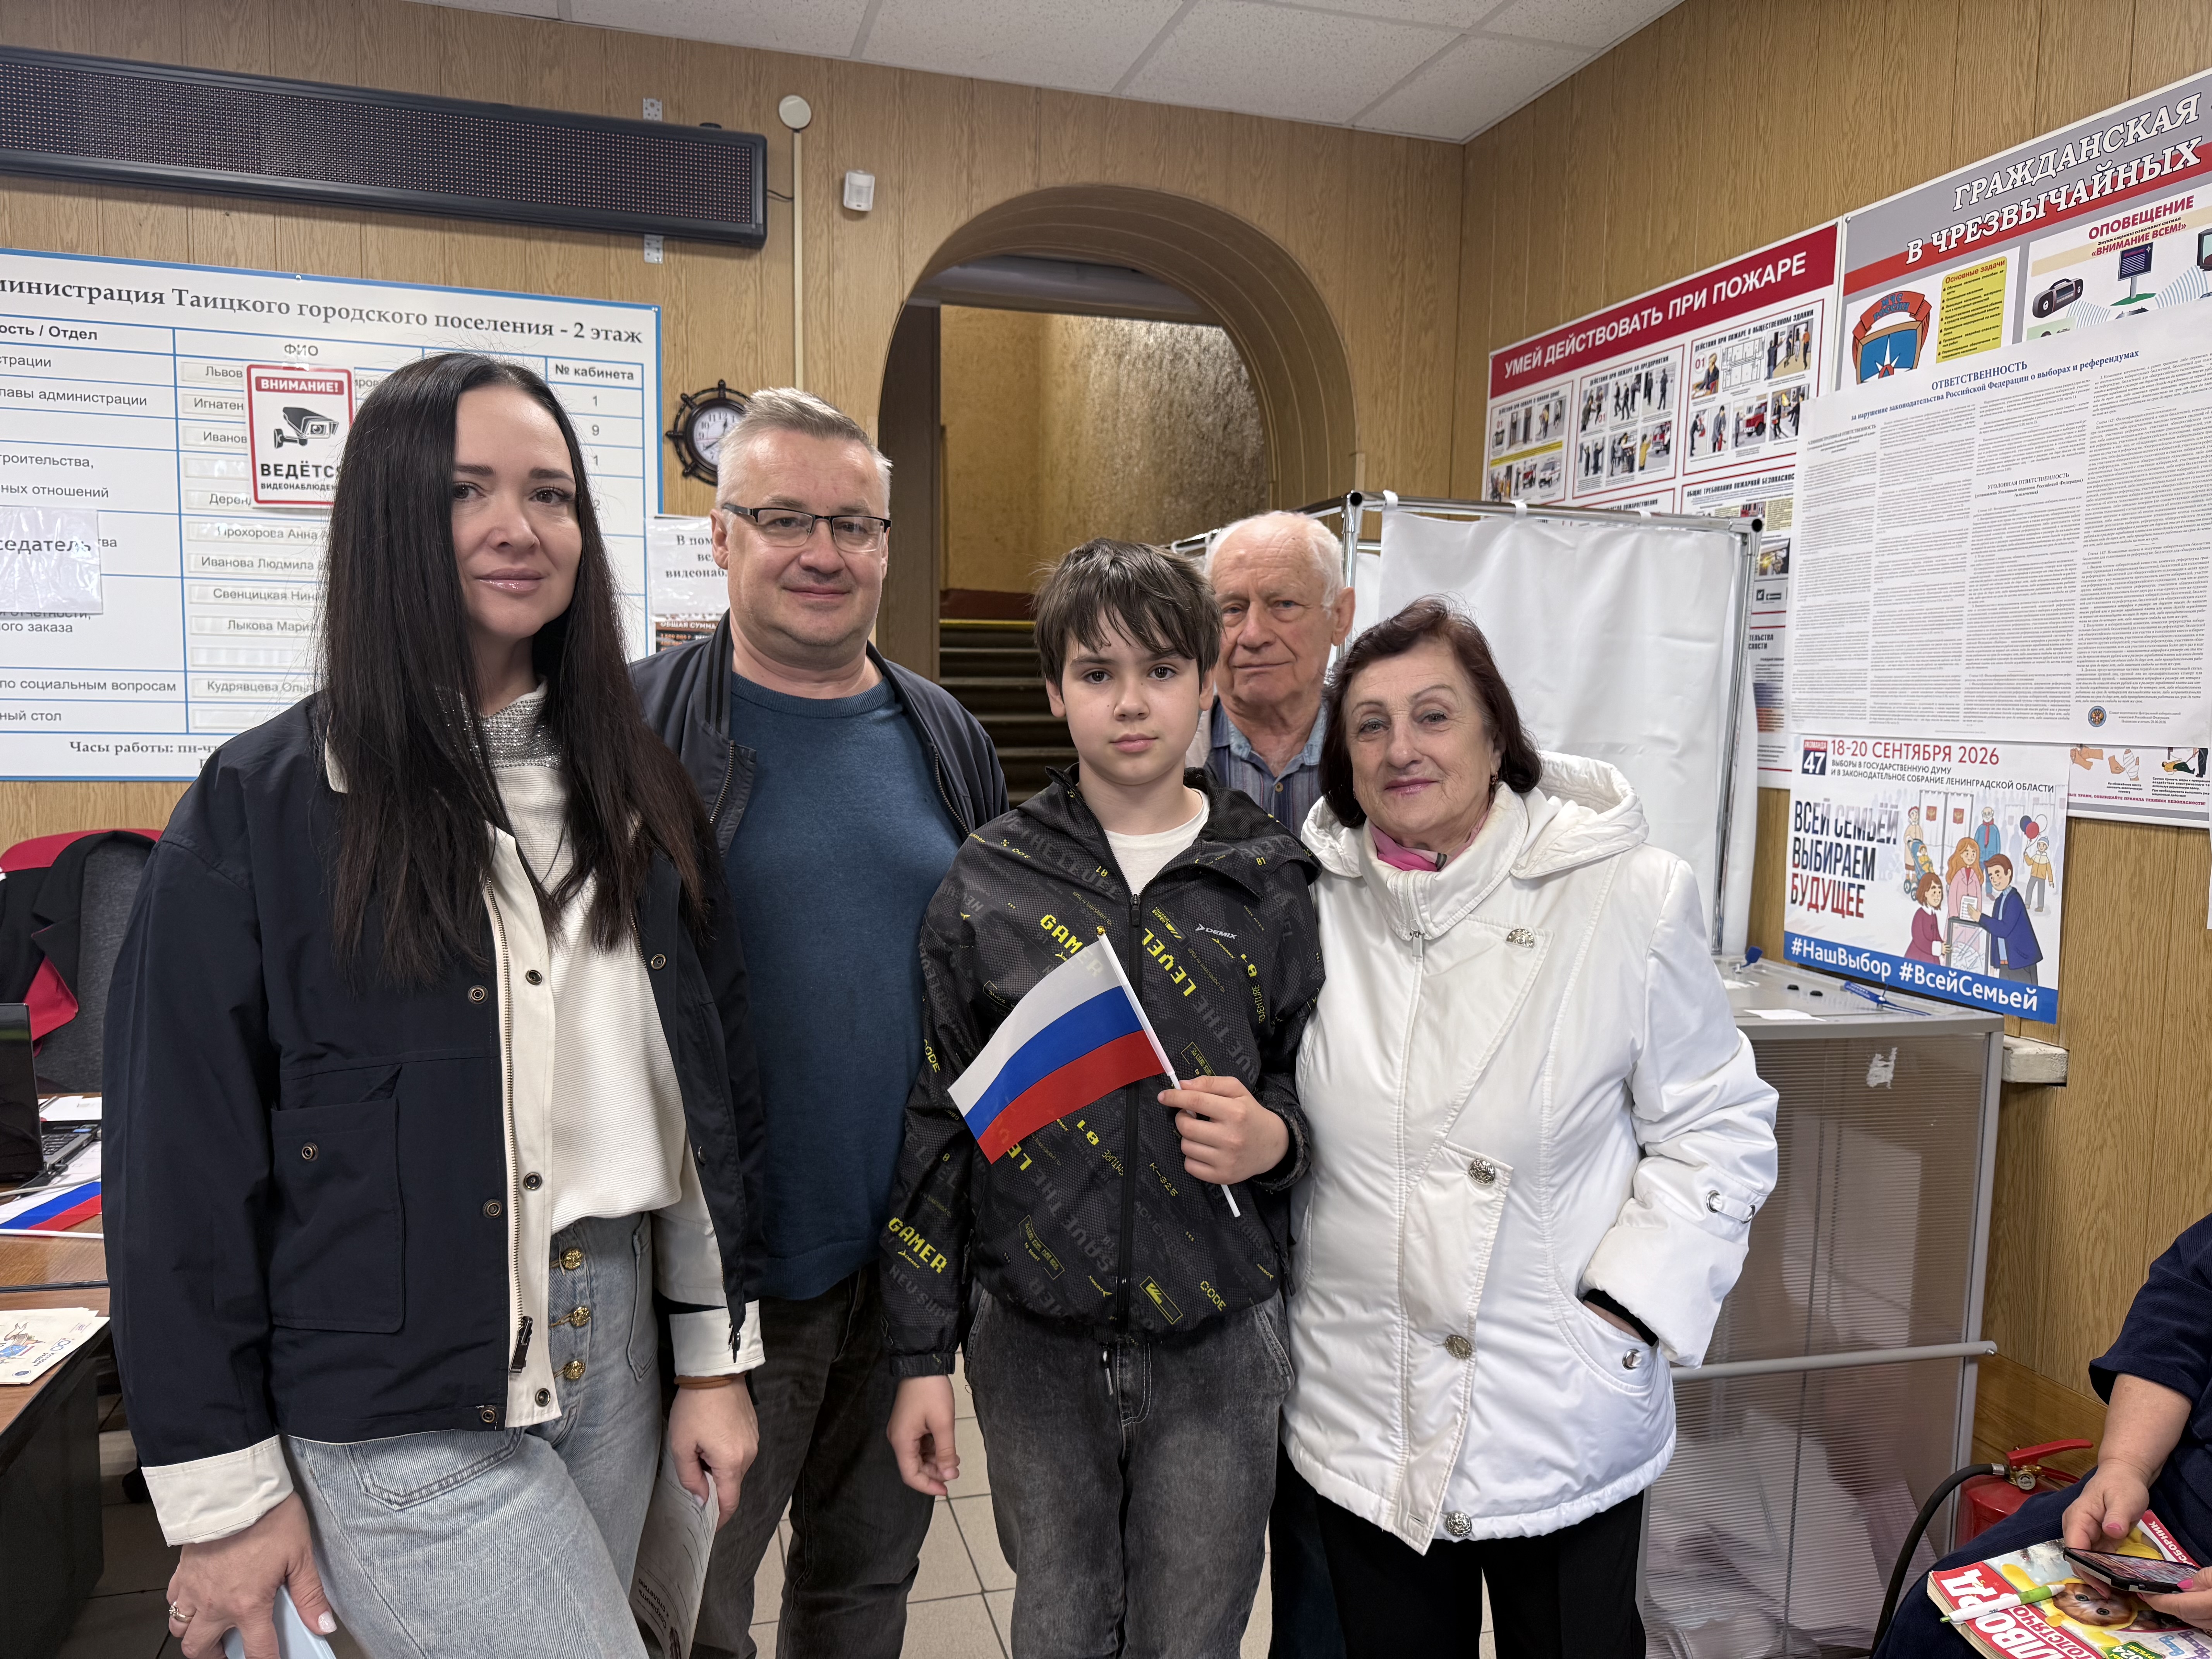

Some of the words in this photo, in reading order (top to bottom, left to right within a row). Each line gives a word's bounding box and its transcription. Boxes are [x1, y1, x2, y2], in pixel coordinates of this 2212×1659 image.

[1953, 92, 2202, 212] ГРАЖДАНСКАЯ
[1906, 238, 1923, 265] В
[1931, 136, 2203, 254] ЧРЕЗВЫЧАЙНЫХ
[2088, 195, 2195, 239] ОПОВЕЩЕНИЕ
[2114, 232, 2134, 242] сирены
[2135, 223, 2161, 234] означают
[2162, 217, 2181, 226] сигнал
[2092, 232, 2150, 257] «ВНИМАНИЕ
[2152, 222, 2187, 239] ВСЕМ!»
[1945, 268, 1979, 284] Основные
[1980, 260, 2005, 273] задачи
[1881, 293, 1903, 307] МЧС
[172, 288, 290, 314] Таицкого
[297, 303, 428, 326] городского
[434, 314, 555, 337] поселения
[574, 322, 585, 339] 2
[591, 328, 643, 344] этаж
[1504, 346, 1543, 379] УМЕЙ
[1544, 306, 1663, 368] ДЕЙСТВОВАТЬ
[1668, 288, 1707, 320] ПРИ
[1712, 251, 1807, 305] ПОЖАРЕ
[1873, 302, 1910, 321] РОССИИ
[48, 326, 98, 341] Отдел
[1695, 339, 1716, 352] ДЕЙСТВИЯ
[1717, 336, 1726, 345] ПРИ
[1728, 330, 1747, 341] ПОЖАРЕ
[1752, 317, 1791, 334] ОБЩЕСТВЕННОМ
[1793, 309, 1814, 321] ЗДАНИИ
[1695, 358, 1705, 369] 01
[205, 366, 243, 378] Львов
[555, 363, 570, 376] №
[574, 366, 634, 381] кабинета
[1931, 361, 2028, 391] ОТВЕТСТВЕННОСТЬ
[261, 378, 339, 393] ВНИМАНИЕ!
[1858, 405, 1888, 420] нарушение
[1889, 394, 1944, 413] законодательства
[1945, 382, 1986, 400] Российской
[1987, 375, 2029, 393] Федерации
[2037, 366, 2071, 383] выборах
[2080, 350, 2139, 372] референдумах
[38, 390, 147, 406] администрации
[194, 397, 244, 410] Игнатен
[592, 395, 598, 407] 1
[591, 424, 600, 436] 9
[593, 455, 599, 466] 1
[1762, 473, 1795, 484] БЕЗОПАСНОС
[1987, 480, 2018, 490] УГОЛОВНАЯ
[2018, 472, 2069, 484] ОТВЕТСТВЕННОСТЬ
[32, 486, 109, 498] отношений
[210, 493, 252, 506] Дерен
[287, 529, 318, 540] Анна
[677, 534, 685, 546] В
[689, 536, 713, 546] пом
[201, 556, 254, 568] Иванова
[258, 558, 314, 571] Людмила
[213, 588, 287, 601] Свенцицкая
[291, 592, 314, 601] Нин
[0, 623, 23, 632] ого
[27, 623, 73, 633] заказа
[227, 620, 273, 631] Лыкова
[277, 622, 312, 633] Мари
[0, 680, 16, 689] по
[20, 680, 106, 691] социальным
[111, 682, 176, 693] вопросам
[207, 680, 279, 693] Кудрявцева
[31, 713, 62, 721] стол
[69, 741, 110, 753] Часы
[115, 742, 173, 756] работы:
[1831, 739, 1867, 757] 18-20
[1872, 742, 1952, 763] СЕНТЯБРЯ
[1958, 746, 1999, 765] 2026
[1803, 750, 1826, 775] 47
[1831, 759, 1857, 768] ВЫБОРЫ
[1863, 762, 1930, 774] ГОСУДАРСТВЕННУЮ
[1930, 766, 1952, 775] ДУМУ
[1841, 769, 1906, 782] ЗАКОНОДАТЕЛЬНОЕ
[1907, 774, 1944, 785] СОБРАНИЕ
[1945, 777, 2014, 790] ЛЕНИНГРАДСКОЙ
[2015, 782, 2054, 793] ОБЛАСТИ
[1794, 798, 1831, 836] ВСЕЙ
[1792, 836, 1876, 881] ВЫБИРАЕМ
[1791, 872, 1865, 918] БУДУЩЕЕ
[1205, 927, 1237, 939] DEMIX
[1040, 914, 1104, 978] GAMER
[1219, 943, 1235, 960] DEMIX
[1791, 937, 1891, 982] #НашВыбор
[1899, 962, 2038, 1012] #ВсейСемьей
[888, 1217, 947, 1274] GAMER
[904, 1255, 921, 1269] DEMIX
[1200, 1280, 1226, 1312] CODE
